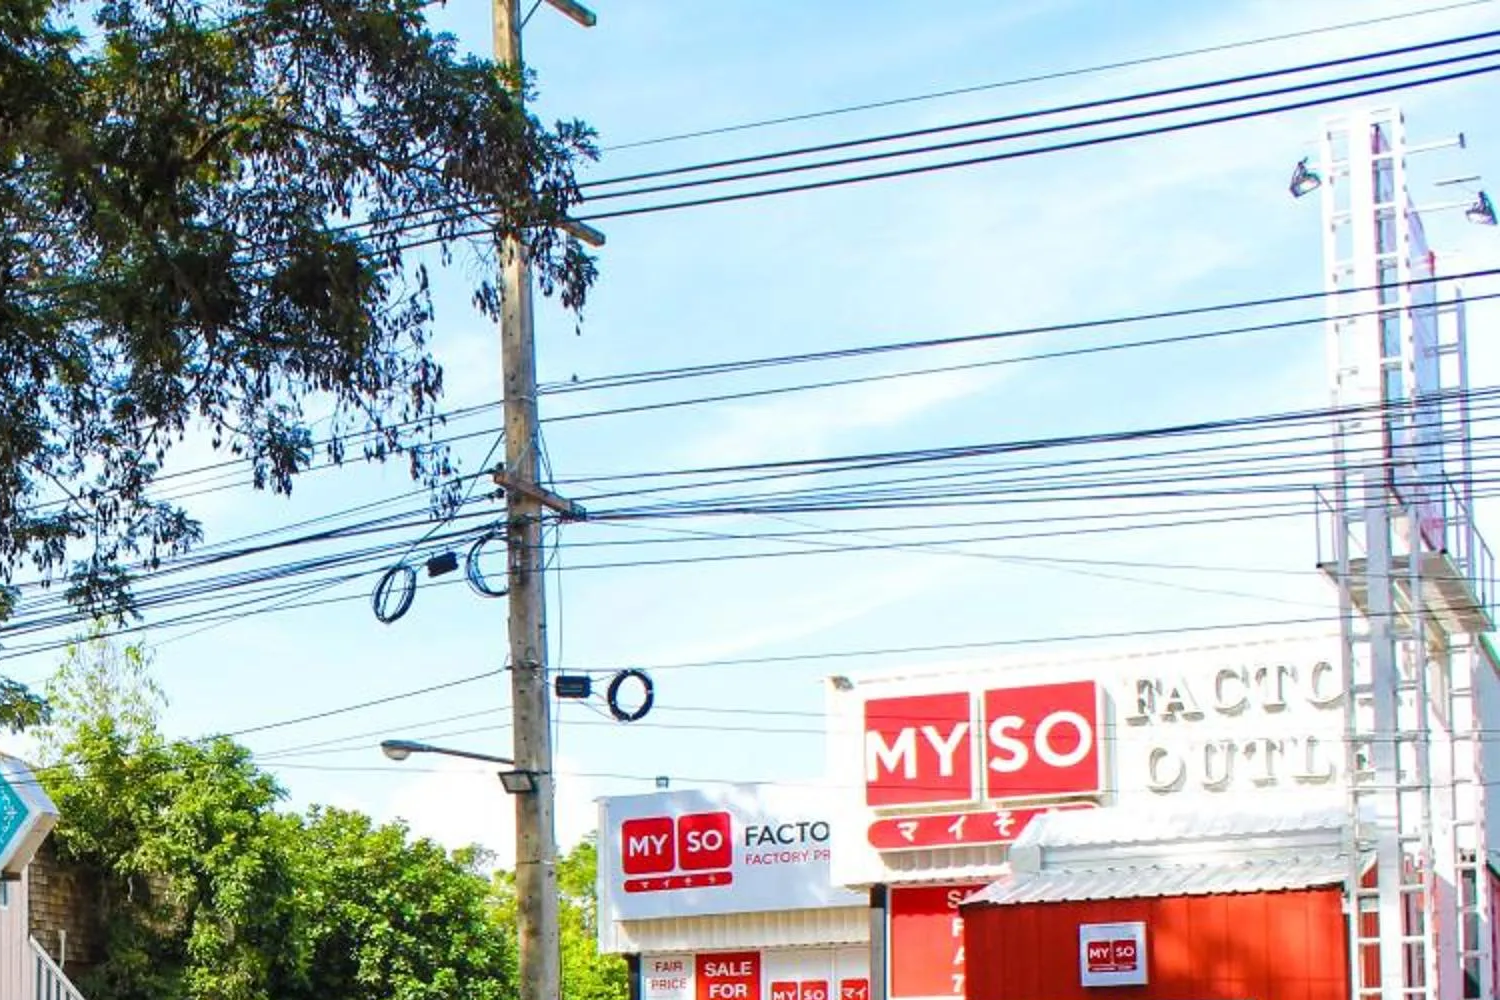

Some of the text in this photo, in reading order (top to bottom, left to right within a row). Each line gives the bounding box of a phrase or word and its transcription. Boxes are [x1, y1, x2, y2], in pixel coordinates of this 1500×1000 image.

[1122, 660, 1349, 727] FACTO
[865, 711, 1092, 783] MY SO
[1145, 735, 1376, 796] OUTL
[744, 820, 831, 847] FACTO
[896, 811, 1016, 842] マイそ
[628, 829, 724, 858] MY SO
[744, 851, 810, 865] FACTORY
[1089, 945, 1135, 959] MY SO
[655, 961, 683, 972] FAIR
[704, 961, 753, 977] SALE
[652, 978, 687, 990] PRICE
[709, 983, 748, 999] FOR
[803, 989, 825, 1000] SO
